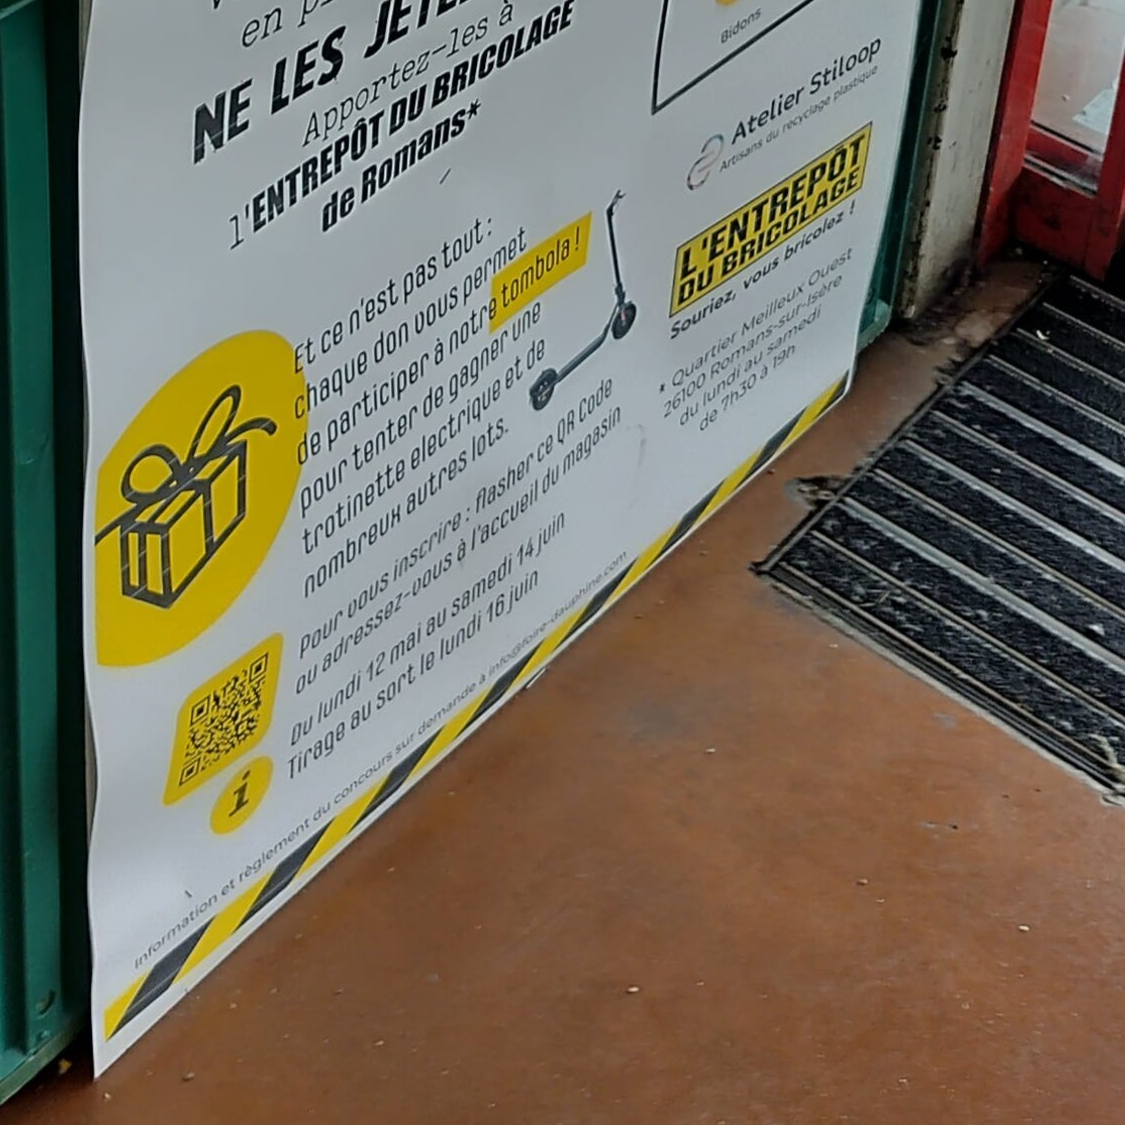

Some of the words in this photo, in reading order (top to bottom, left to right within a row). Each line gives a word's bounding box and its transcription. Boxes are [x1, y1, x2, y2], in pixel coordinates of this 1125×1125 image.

[193, 79, 253, 165] NE
[270, 25, 346, 115] LES
[242, 8, 283, 48] en
[303, 16, 488, 147] Apportez-les
[721, 8, 761, 44] Bidons
[731, 87, 805, 145] Atelier
[809, 38, 881, 95] Stiloop
[389, 83, 427, 136] DU
[719, 137, 763, 173] Artisans
[766, 125, 779, 143] du
[782, 95, 831, 135] recyclage
[833, 65, 877, 101] plastique
[322, 183, 355, 233] de
[670, 289, 737, 340] Souriez,
[743, 257, 779, 289] vous
[785, 211, 844, 261] bricolez
[678, 269, 713, 306] DU
[721, 166, 861, 278] BRICOLAGE
[295, 337, 315, 375] Et
[321, 321, 343, 354] ce
[350, 278, 398, 335] n'est
[404, 255, 437, 304] pas
[295, 351, 367, 419] chaque
[374, 321, 409, 364] don
[415, 285, 458, 334] vous
[463, 226, 527, 305] permet
[297, 430, 321, 465] de
[327, 354, 430, 452] participer
[434, 338, 444, 365] à
[449, 298, 497, 355] notre
[501, 240, 570, 309] tombola
[664, 374, 706, 418] 26100
[710, 274, 842, 379] Romans-sur-Isère
[672, 332, 737, 386] Quartier
[741, 283, 804, 336] Meilleux
[809, 248, 852, 286] Ouest
[680, 402, 698, 425] du
[703, 362, 739, 406] lundi
[744, 352, 762, 373] au
[766, 306, 821, 356] samedi
[300, 459, 347, 519] pour
[352, 406, 418, 471] tenter
[423, 388, 444, 418] de
[449, 336, 508, 404] gagner
[513, 302, 541, 340] une
[302, 461, 405, 555] trotinette
[411, 376, 501, 470] electrique
[505, 355, 523, 389] et
[527, 339, 545, 369] de
[700, 409, 717, 431] de
[723, 378, 756, 412] 7h30
[760, 365, 768, 380] à
[773, 344, 795, 369] 19h
[295, 667, 318, 695] ou
[323, 554, 453, 672] adressez-vous
[457, 540, 466, 562] à
[471, 487, 538, 551] l'accueil
[541, 462, 560, 495] du
[563, 405, 621, 474] magasin
[300, 606, 344, 660] Pour
[348, 571, 389, 618] vous
[394, 511, 462, 582] inscrire
[475, 451, 533, 514] flasher
[537, 437, 554, 462] ce
[557, 411, 576, 446] QR
[578, 379, 613, 424] Code
[305, 505, 401, 599] nombreux
[407, 450, 467, 515] autres
[472, 418, 509, 462] lots.
[287, 719, 346, 780] Tirage
[351, 701, 372, 729] au
[377, 664, 416, 713] sort
[419, 649, 435, 678] le
[439, 611, 481, 661] lundi
[487, 593, 504, 625] 16
[506, 569, 538, 617] juin
[291, 715, 315, 747] Du
[319, 670, 361, 724] lundi
[368, 652, 386, 682] 12
[390, 628, 422, 663] mai
[426, 605, 446, 634] au
[452, 552, 512, 618] samedi
[516, 542, 534, 569] 14
[536, 510, 566, 559] juin
[221, 879, 235, 897] et
[239, 818, 310, 884] règlement
[313, 803, 331, 821] du
[334, 751, 393, 805] concours
[395, 733, 414, 754] sur
[418, 683, 476, 735] demande
[479, 672, 486, 684] à
